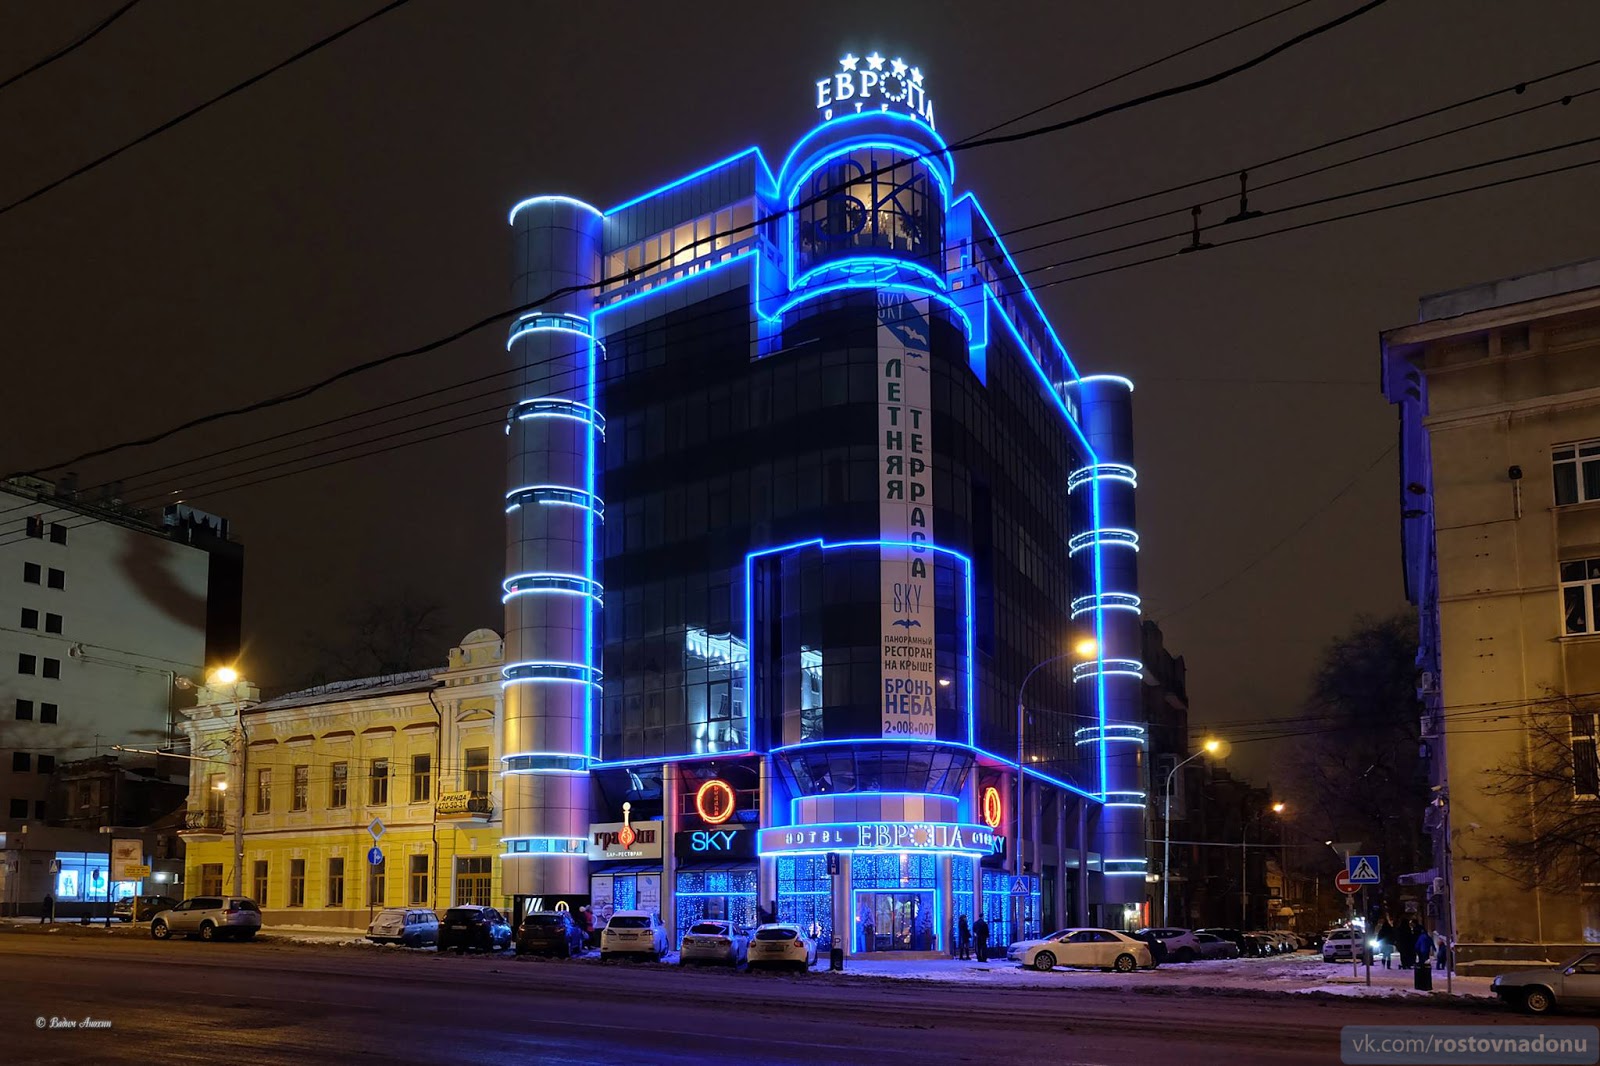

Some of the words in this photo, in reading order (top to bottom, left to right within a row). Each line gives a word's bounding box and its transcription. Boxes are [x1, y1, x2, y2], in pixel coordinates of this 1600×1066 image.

[816, 70, 936, 131] ЕВРОПА
[877, 292, 904, 320] SKY
[886, 358, 903, 500] ЛЕТНЯЯ
[910, 408, 927, 578] ТЕРРАСА
[893, 582, 922, 614] SKY
[884, 635, 933, 645] ПАНОРАМНЫЙ
[884, 646, 933, 659] РЕСТОРАН
[884, 659, 897, 670] НА
[899, 659, 933, 673] КРЫШЕ
[885, 678, 933, 696] БРОНЬ
[885, 694, 933, 717] НЕБА
[691, 830, 737, 851] SKY
[857, 824, 966, 849] ЕВРОПА
